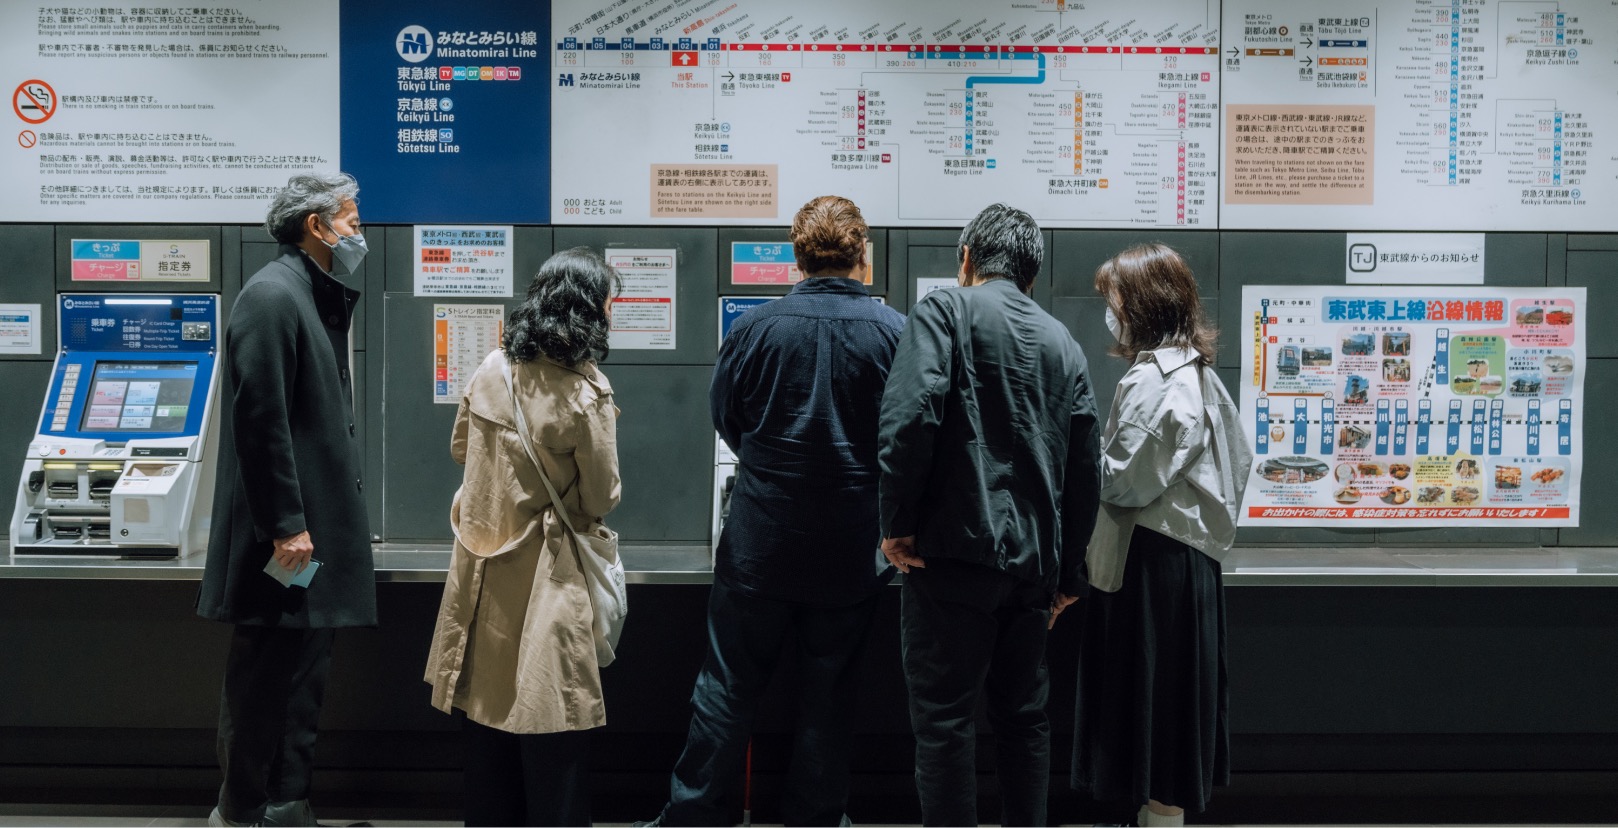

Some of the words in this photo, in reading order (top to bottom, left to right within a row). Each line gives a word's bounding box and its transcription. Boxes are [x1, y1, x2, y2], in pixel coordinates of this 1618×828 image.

[568, 8, 606, 35] 元町・中華街
[596, 12, 629, 35] 日本大通り
[625, 19, 647, 35] 馬車道
[654, 8, 694, 35] みなとみらい
[1318, 18, 1358, 26] 東武東上線
[683, 20, 704, 35] 新高島
[712, 22, 727, 35] 横浜
[437, 31, 538, 46] みなとみらい線
[437, 48, 508, 58] Minatomirai
[513, 48, 537, 58] Line
[397, 67, 438, 80] 東急線
[580, 73, 640, 81] みなとみらい線
[677, 73, 693, 81] 当駅
[739, 73, 779, 81] 東急東横線
[1158, 72, 1199, 81] 東急池上線
[1317, 72, 1357, 81] 西武池袋線
[398, 81, 426, 92] Tōkyū
[430, 82, 450, 90] Line
[62, 96, 158, 104] 駅構内及び車内は禁煙です。
[397, 98, 438, 111] 京急線
[397, 112, 430, 124] Keikyū
[434, 112, 454, 122] Line
[695, 123, 719, 132] 京急線
[40, 132, 212, 141] 危険品は、駅や車内に持ち込むことはできません。
[397, 129, 438, 142] 相鉄線
[398, 143, 435, 152] Sōtetsu
[439, 143, 460, 152] Line
[695, 144, 719, 152] 相鉄線
[658, 170, 768, 178] 京急線・相鉄線各駅までの運賃は、
[658, 179, 772, 187] 運賃表の右側に表示してあります。
[1522, 190, 1569, 198] 京急久里浜線
[92, 242, 120, 252] きっぷ
[753, 246, 782, 255] きっぷ
[1353, 253, 1373, 264] TJ
[1380, 253, 1480, 263] 東武線からのお知らせ
[89, 262, 123, 272] チャージ
[158, 261, 191, 271] 指定券
[750, 266, 785, 275] チャージ
[1328, 299, 1504, 321] 東武東上線沿線情報
[91, 318, 115, 327] 乗車券
[1258, 413, 1267, 444] 池袋
[1296, 412, 1306, 444] 大山
[1323, 412, 1332, 444] 和光市
[1378, 413, 1388, 444] 川越
[1396, 413, 1406, 445] 川越市
[1418, 414, 1430, 445] 坂戸
[1449, 414, 1459, 445] 高坂
[1473, 414, 1483, 445] 東松山
[1491, 410, 1500, 448] 森林公園
[1529, 414, 1538, 445] 小川町
[1560, 414, 1569, 445] 寄居
